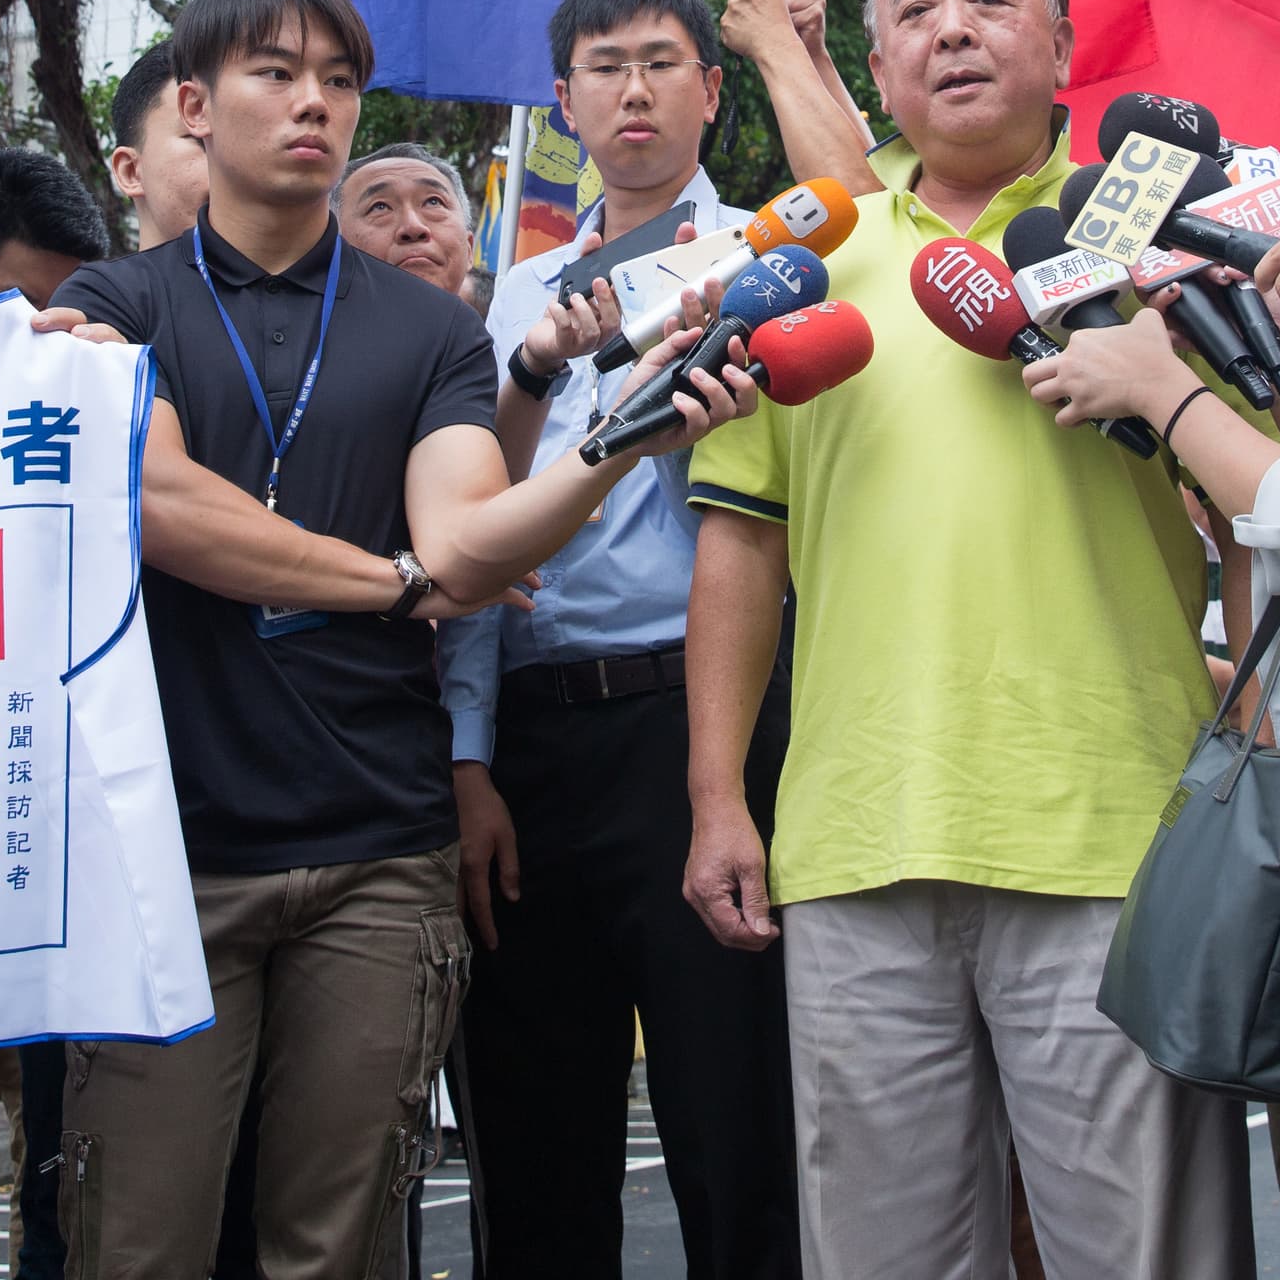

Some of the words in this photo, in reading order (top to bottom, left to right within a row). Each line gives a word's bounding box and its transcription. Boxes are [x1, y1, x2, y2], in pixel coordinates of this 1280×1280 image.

[1112, 150, 1192, 259] 東森新聞
[740, 274, 781, 308] 中天
[925, 246, 1011, 332] 台視
[0, 400, 81, 486] 者
[6, 691, 34, 891] 新聞採訪記者
